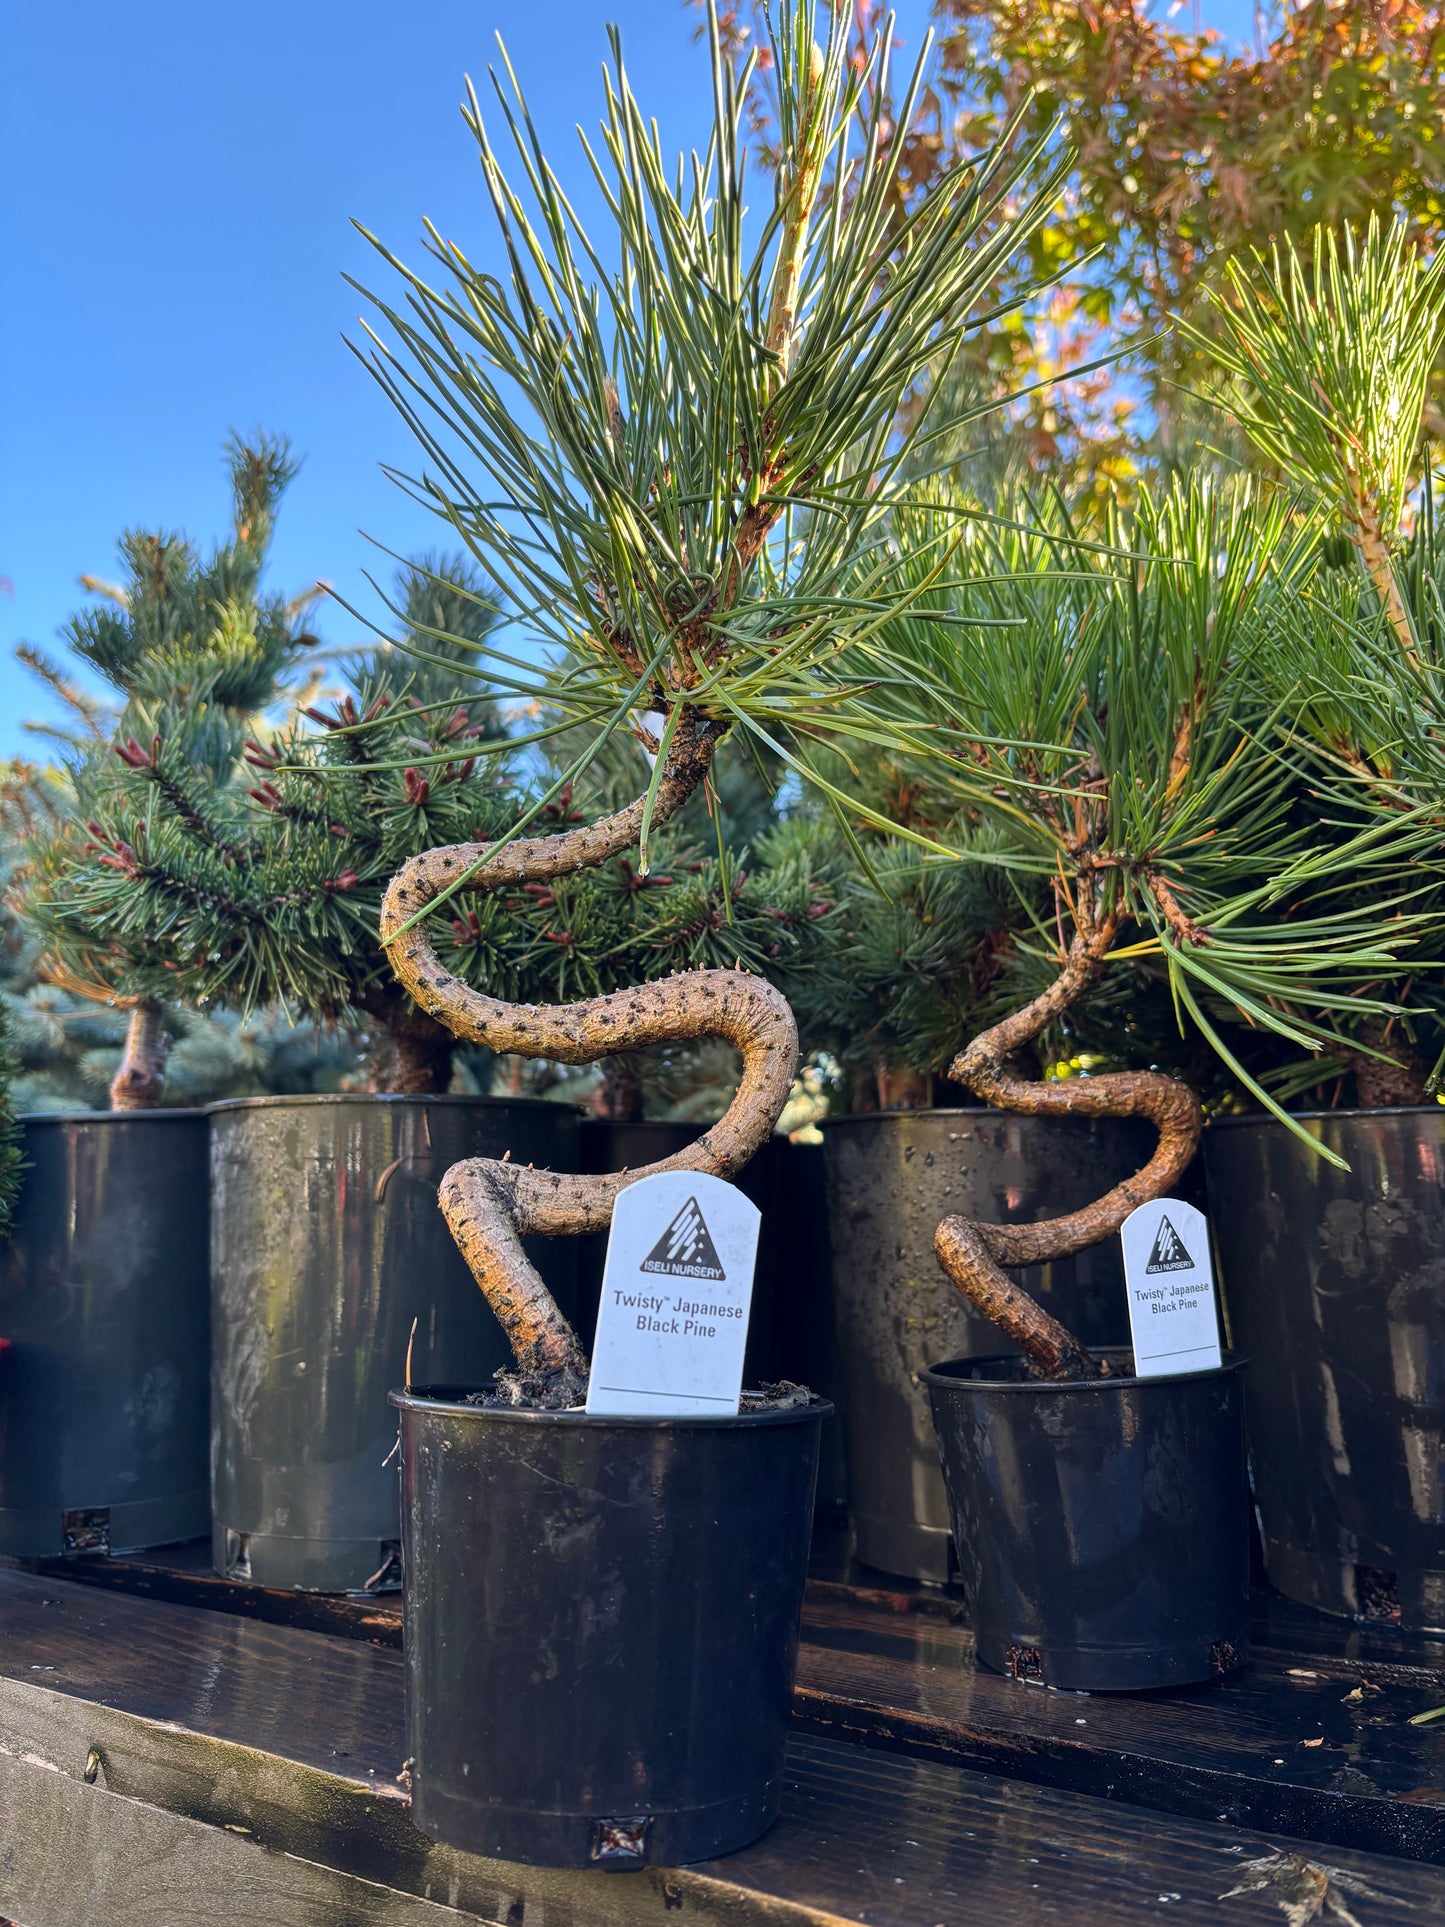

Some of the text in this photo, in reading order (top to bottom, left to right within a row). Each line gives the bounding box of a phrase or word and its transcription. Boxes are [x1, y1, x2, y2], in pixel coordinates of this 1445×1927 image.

[644, 1260, 722, 1279] ISELI NURSERY
[1147, 1261, 1192, 1273] ISELI NURSERY
[1169, 1283, 1209, 1297] Japanese
[673, 1297, 743, 1319] Japanese
[1152, 1299, 1197, 1314] Black Pine
[636, 1315, 716, 1338] Black Pine
